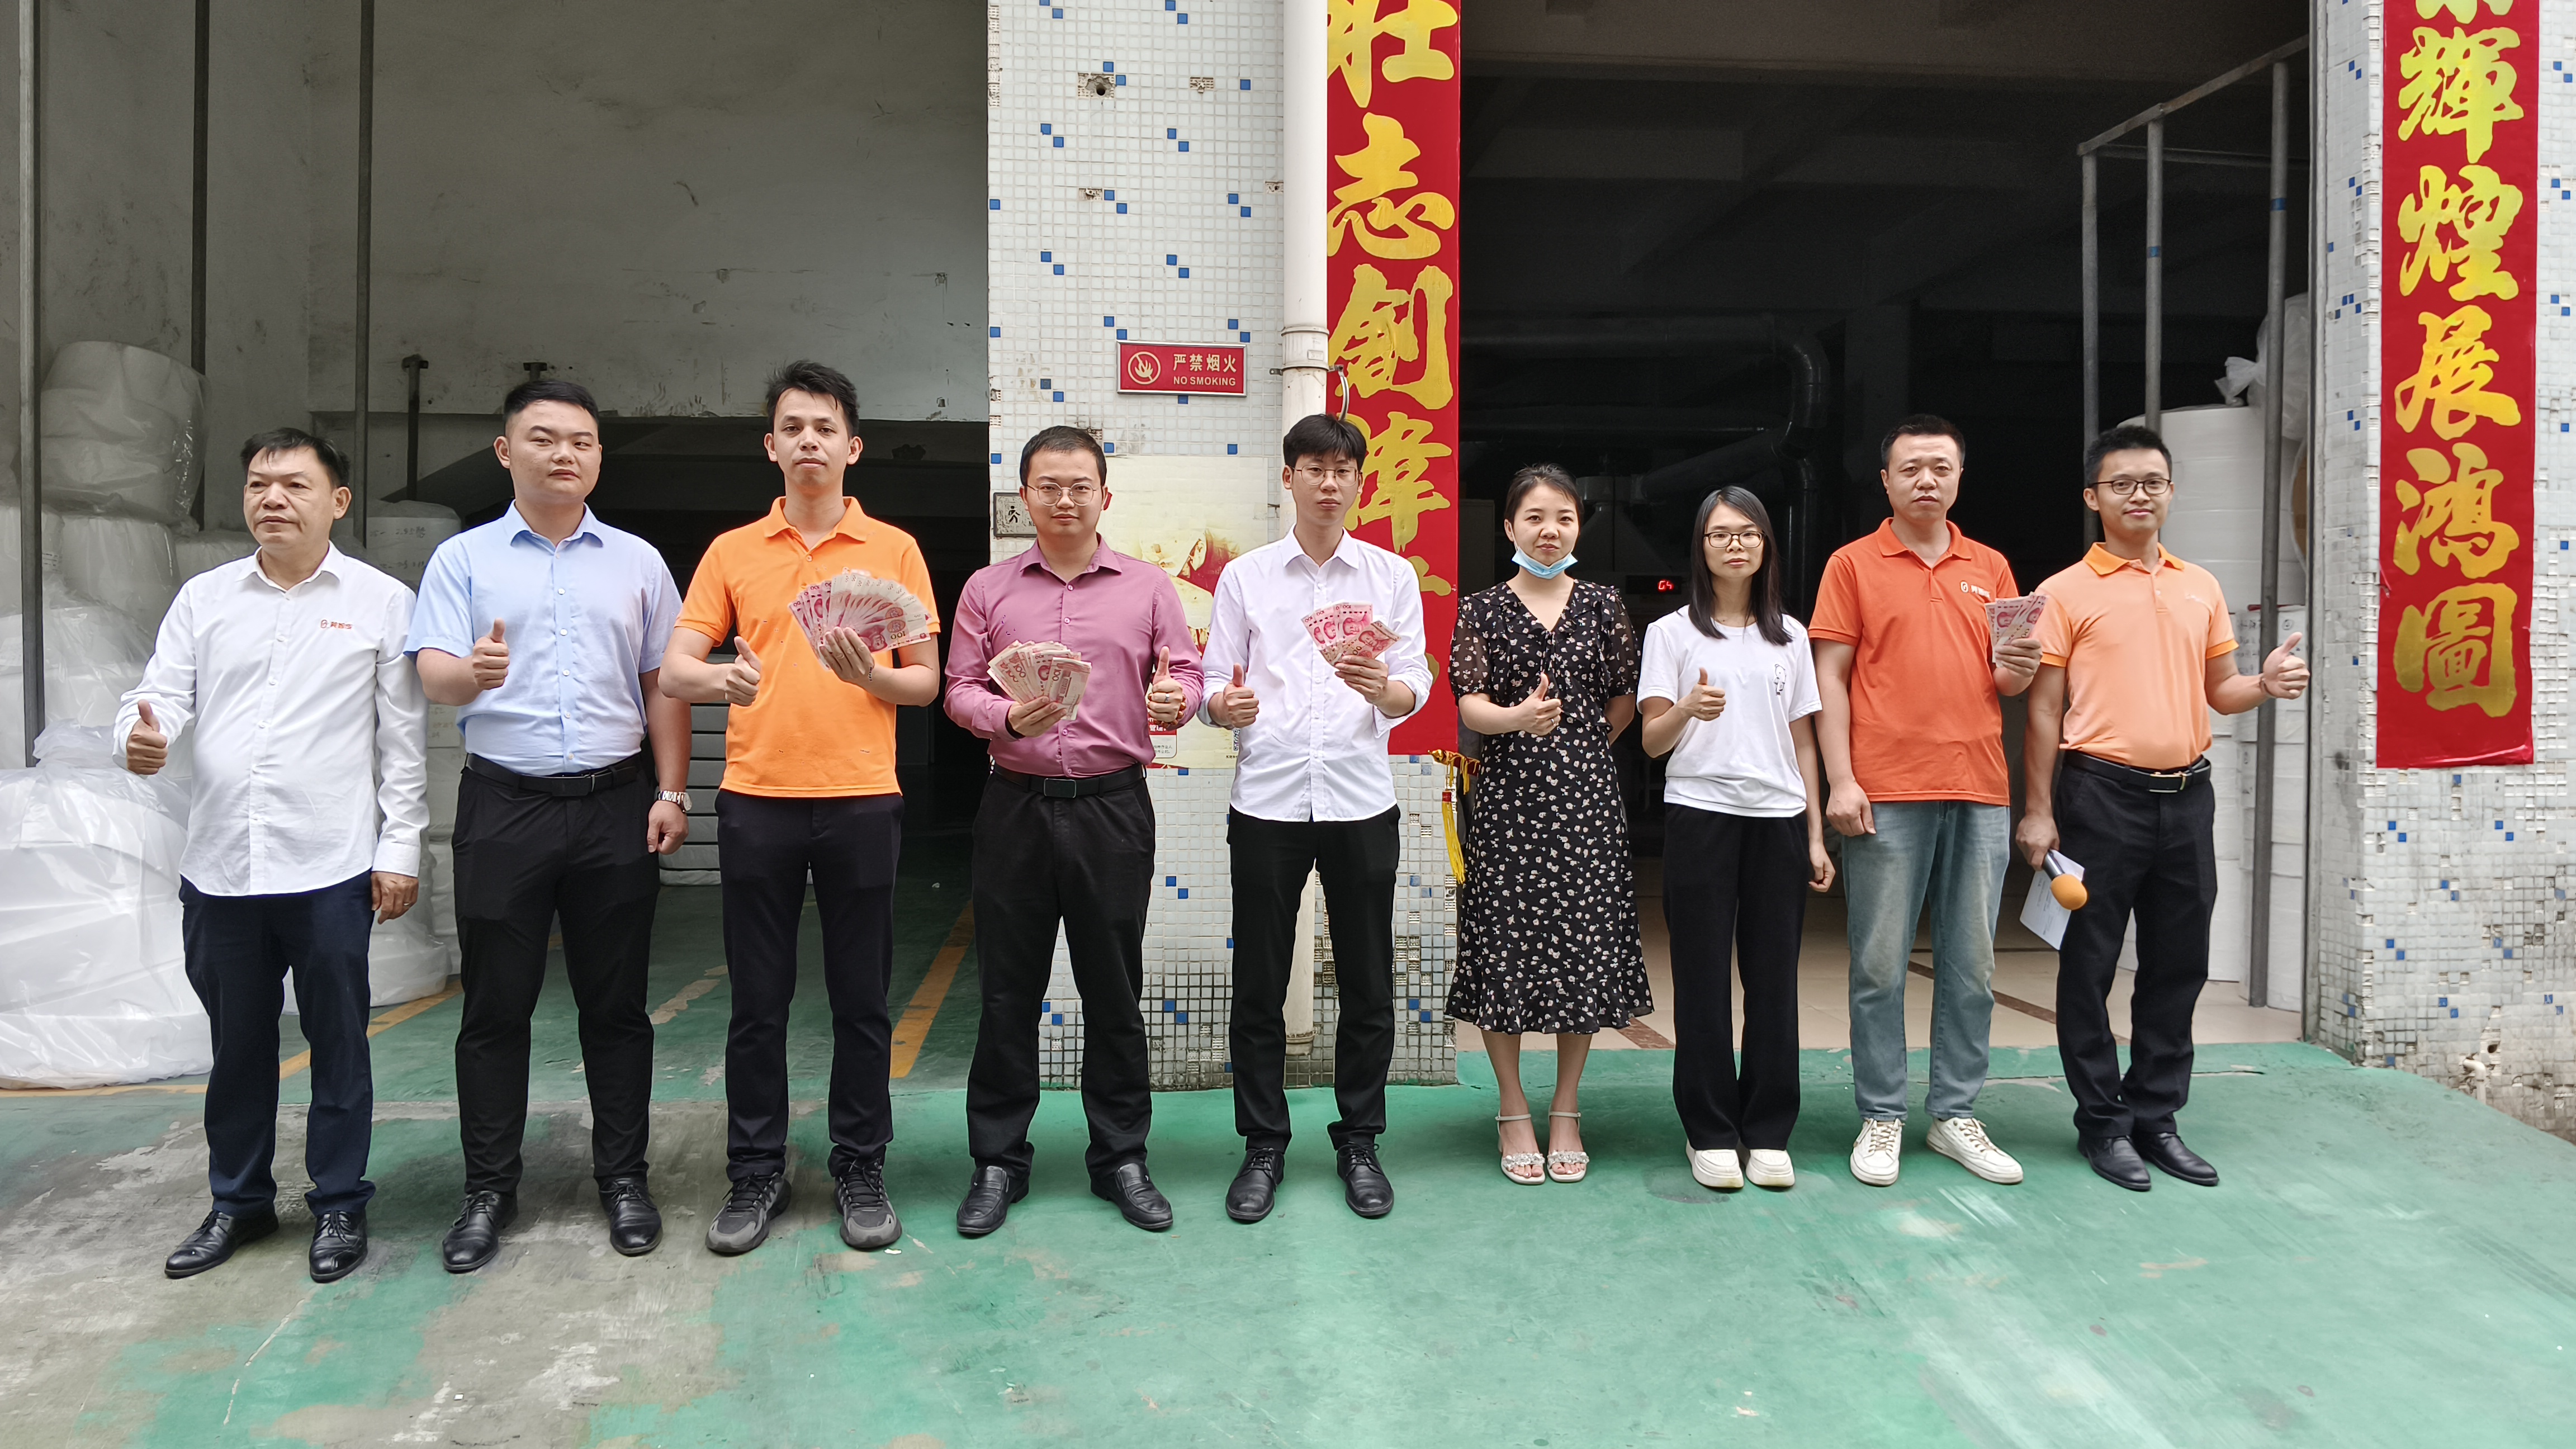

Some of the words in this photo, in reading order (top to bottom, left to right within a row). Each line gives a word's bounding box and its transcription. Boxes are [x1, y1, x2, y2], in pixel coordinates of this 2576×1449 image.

[1173, 353, 1237, 373] 严禁烟火
[2393, 0, 2524, 718] 輝煌展鴻圖
[1173, 376, 1188, 385] NO
[1190, 376, 1237, 386] SMOKING
